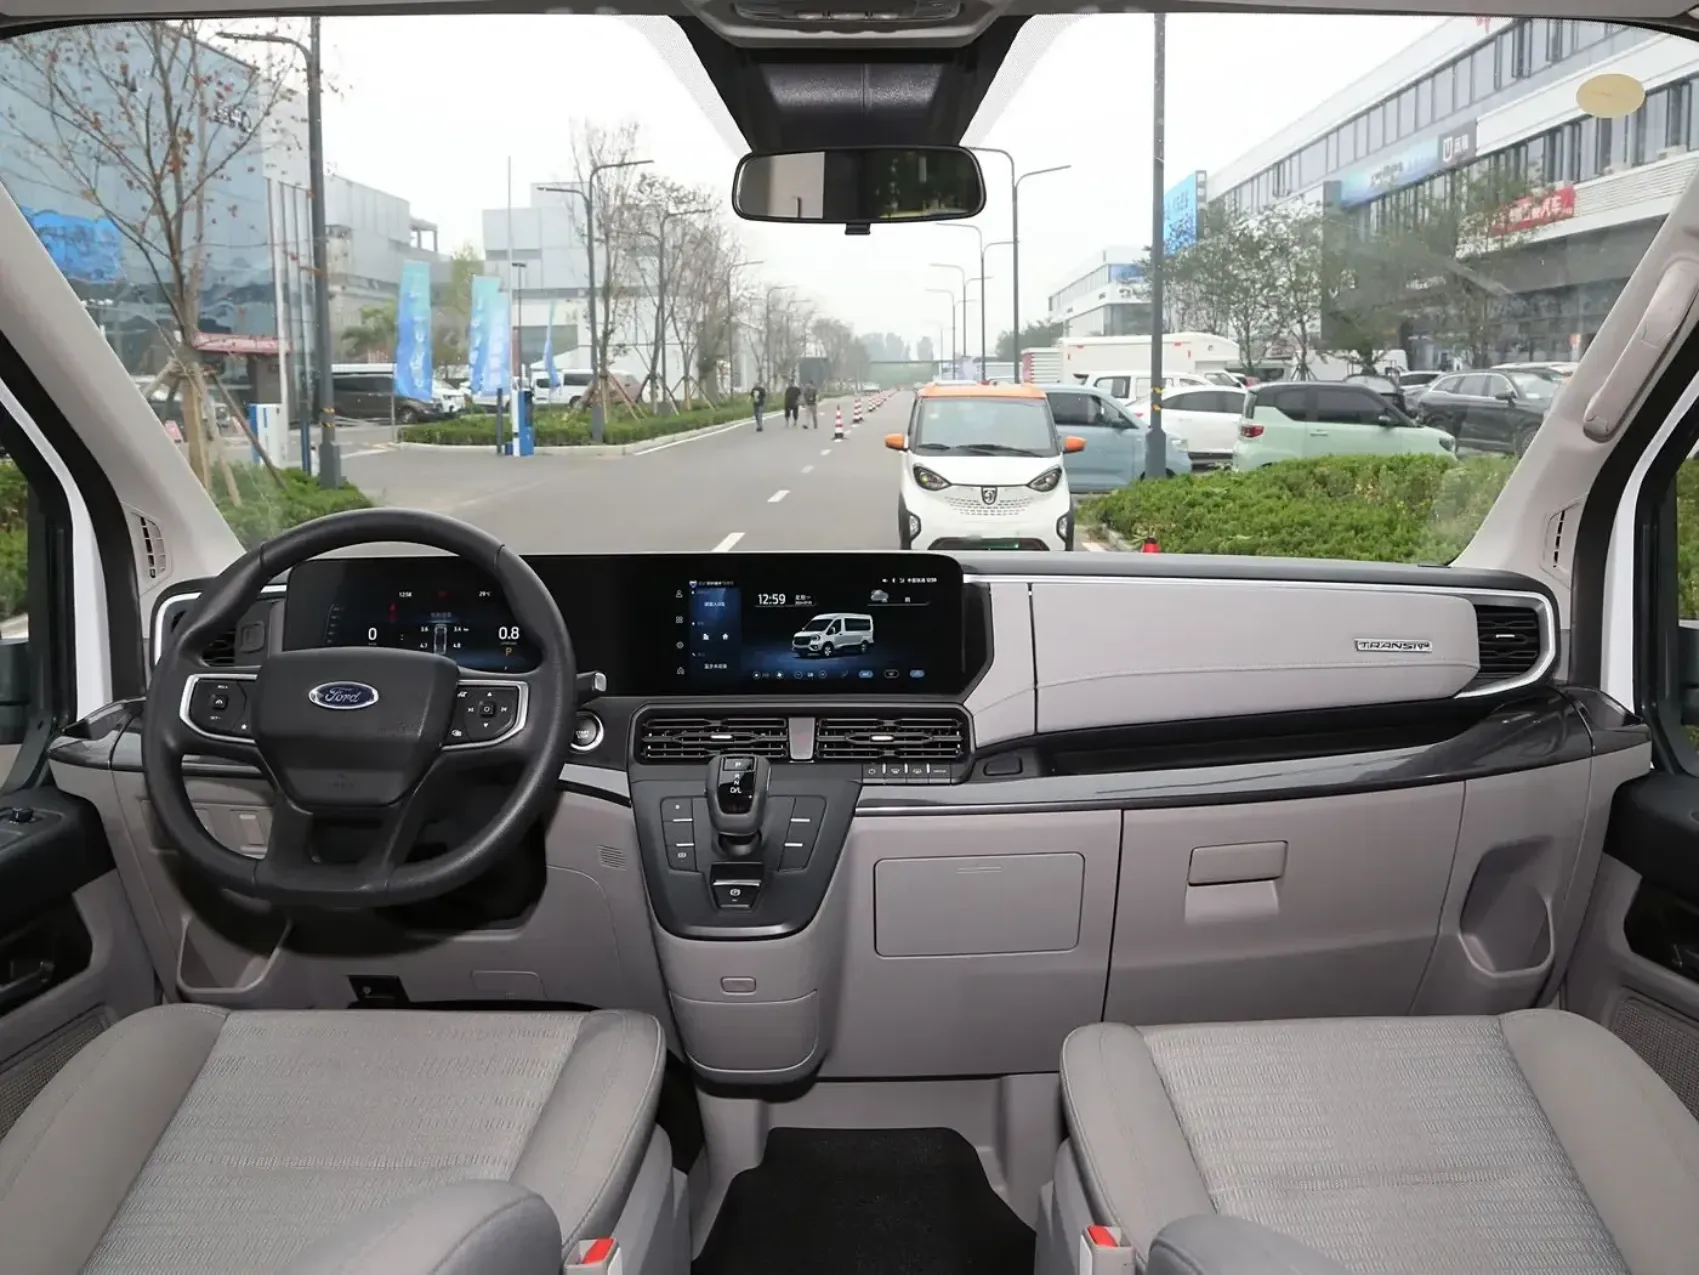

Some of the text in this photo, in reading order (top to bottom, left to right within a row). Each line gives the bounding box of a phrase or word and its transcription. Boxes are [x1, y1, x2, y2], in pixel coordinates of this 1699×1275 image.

[758, 593, 786, 605] 12:59
[368, 627, 377, 641] 0
[498, 626, 520, 640] 0.8
[505, 647, 513, 656] P
[325, 686, 362, 702] Ford
